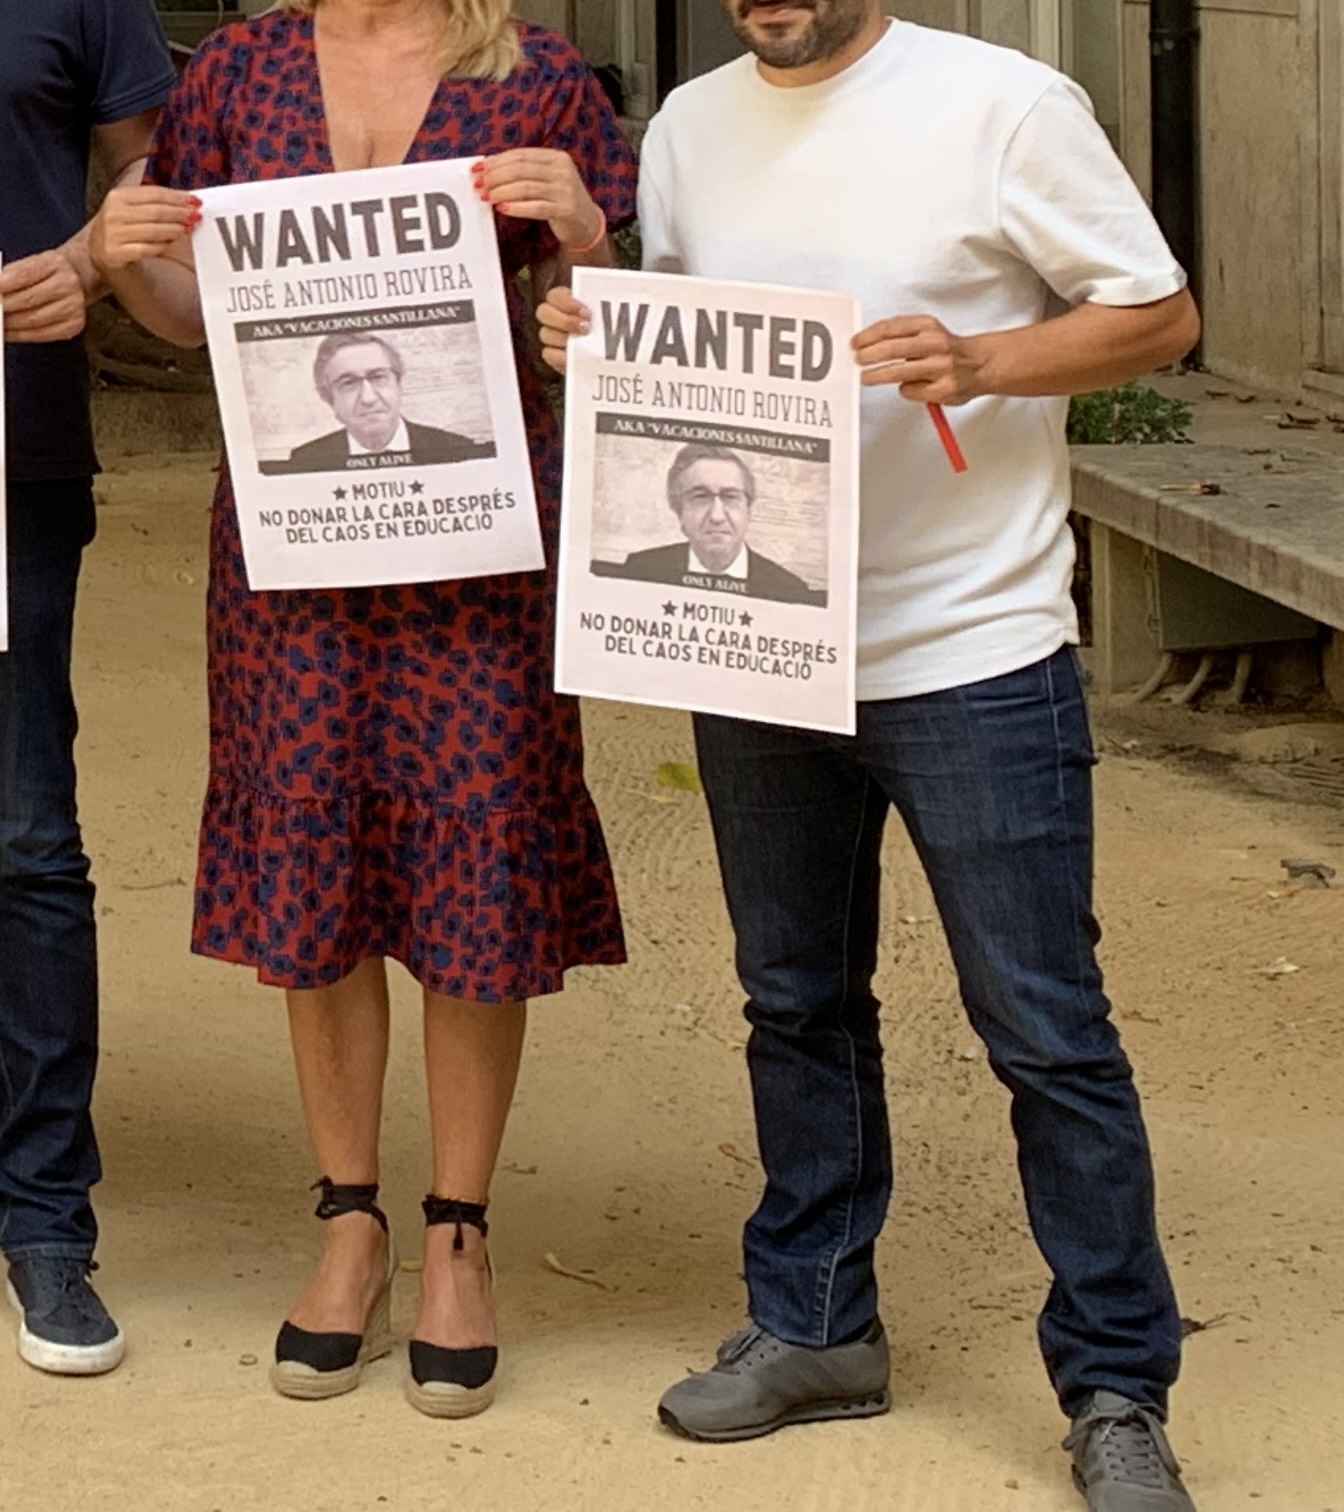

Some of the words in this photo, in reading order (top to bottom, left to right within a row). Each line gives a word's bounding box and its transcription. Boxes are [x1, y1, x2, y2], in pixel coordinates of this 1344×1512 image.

[217, 191, 462, 272] WANTED
[226, 278, 277, 313] JOSÉ
[283, 272, 379, 309] ANTONIO
[383, 263, 473, 297] ROVIRA
[253, 324, 284, 337] AKA
[600, 300, 834, 383] WANTED
[591, 372, 644, 406] JOSÉ
[650, 380, 746, 417] ANTONIO
[752, 390, 834, 428] ROVIRA
[614, 419, 645, 433] AKA
[258, 510, 284, 528] NO
[287, 506, 348, 526] DONAR
[351, 505, 375, 522] LA
[378, 500, 429, 520] CARA
[432, 487, 516, 516] DESPRÉS
[351, 480, 406, 501] MOTIU
[285, 527, 318, 545] DEL
[321, 523, 371, 543] CAOS
[374, 522, 399, 540] EN
[402, 509, 494, 538] EDUCACIÓ
[682, 601, 736, 626] MOTIU
[580, 613, 606, 632] NO
[610, 615, 673, 640] DONAR
[678, 624, 700, 644] LA
[704, 627, 752, 652] CARA
[757, 635, 837, 665] DESPRÉS
[604, 634, 637, 656] DEL
[642, 639, 692, 663] CAOS
[697, 646, 720, 667] EN
[725, 651, 813, 681] EDUCACIÓ
